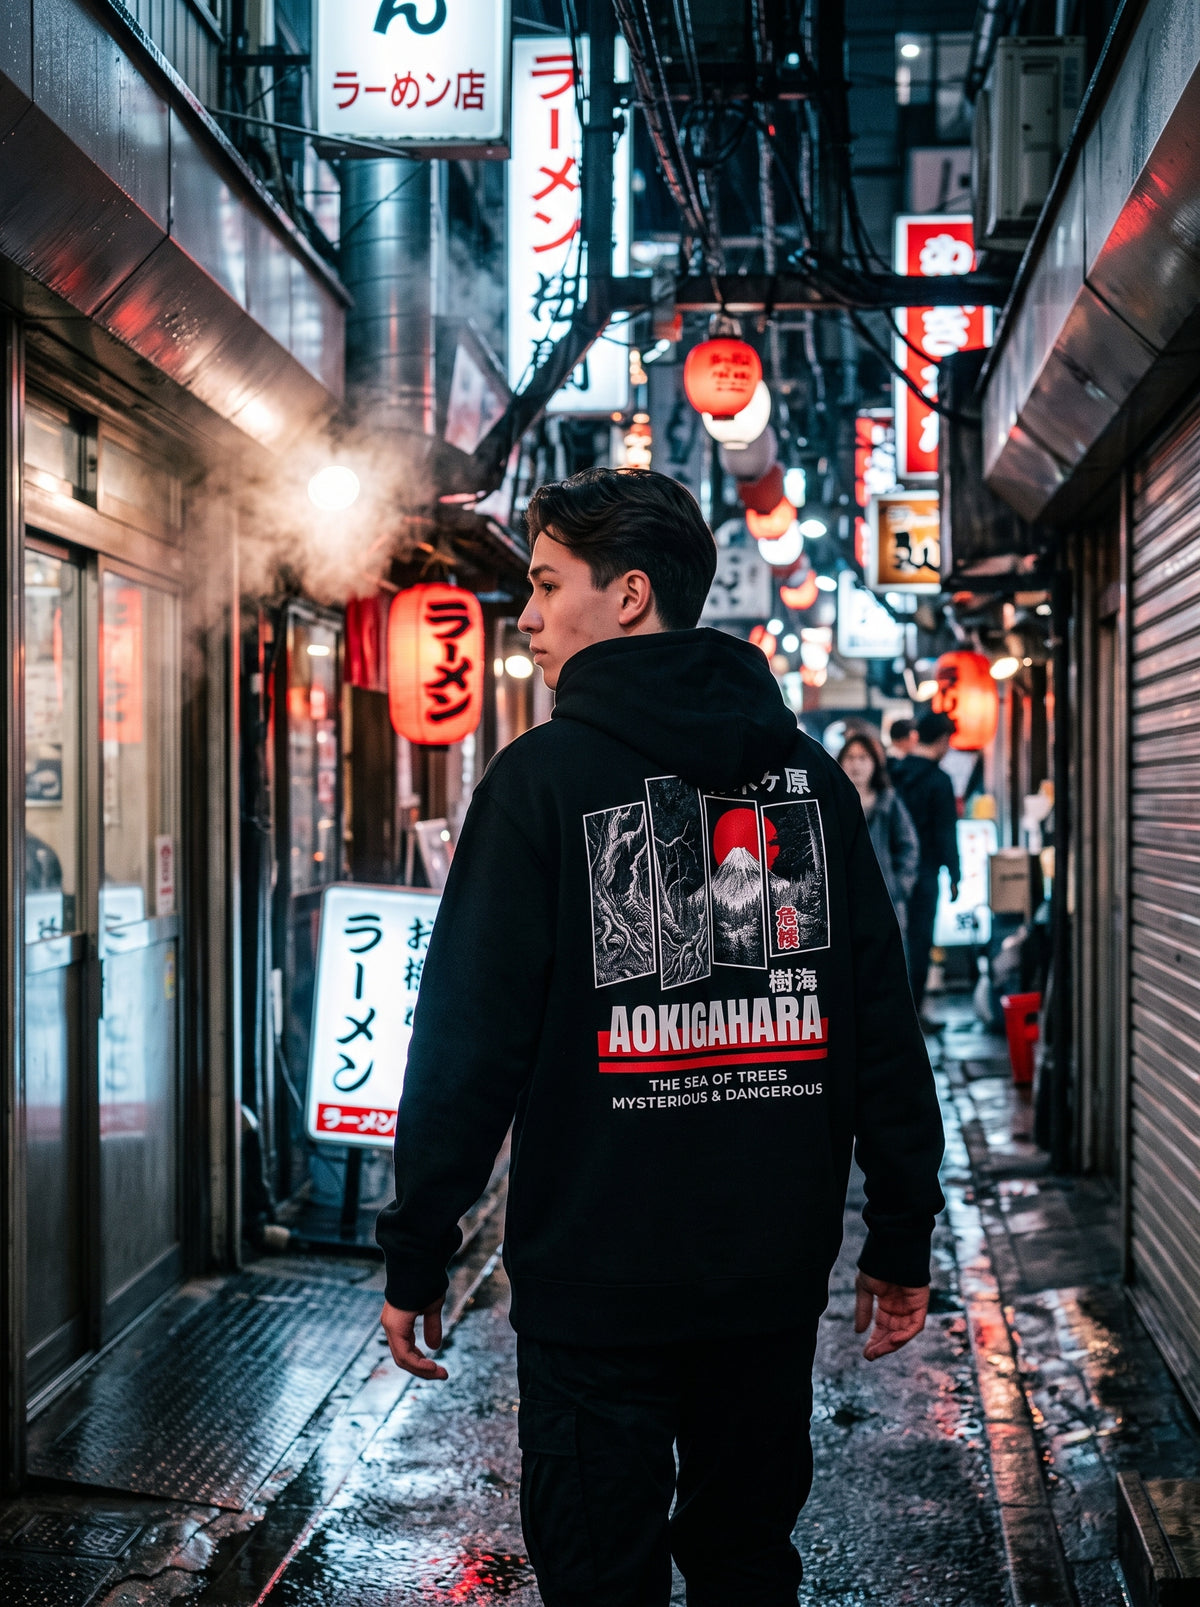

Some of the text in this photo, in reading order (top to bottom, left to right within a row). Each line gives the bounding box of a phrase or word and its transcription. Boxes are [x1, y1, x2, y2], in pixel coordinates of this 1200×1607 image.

[333, 68, 485, 110] ラーめン店
[530, 55, 582, 253] ラーメン
[425, 602, 472, 722] ラーメン
[332, 914, 384, 1093] ラーメン
[769, 967, 818, 994] 樹海
[608, 994, 823, 1053] AOKIGAHARA
[612, 1083, 823, 1110] MYSTERIOUS & DANGEROUS
[649, 1069, 788, 1092] THE SEA OF TREES
